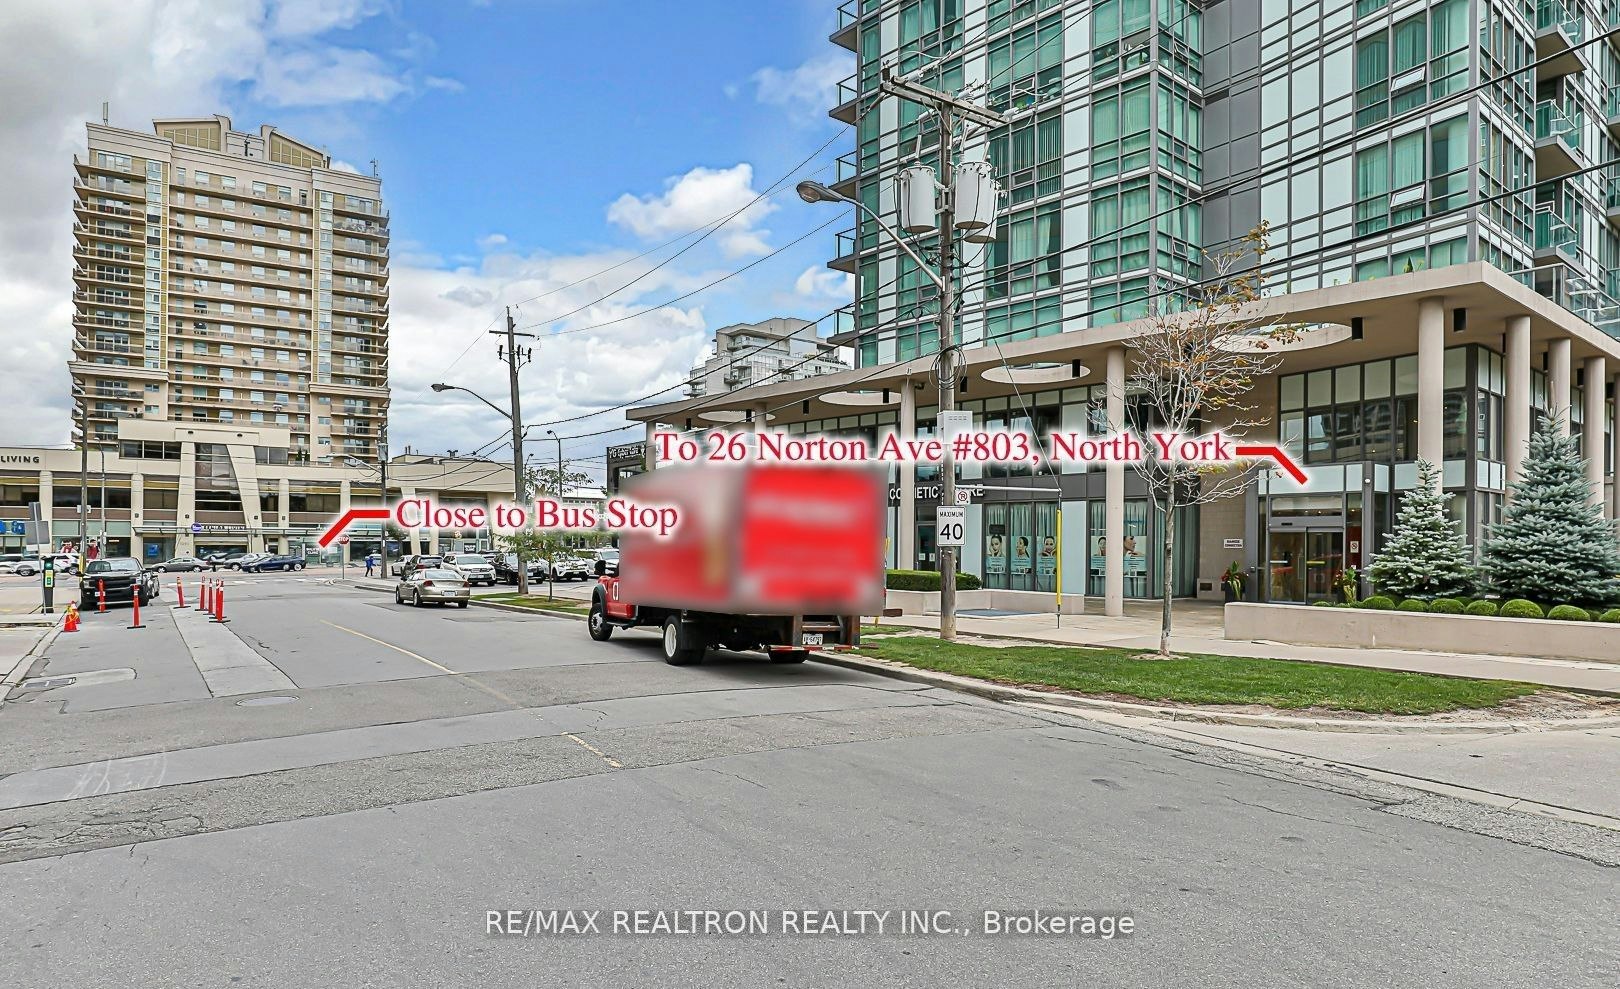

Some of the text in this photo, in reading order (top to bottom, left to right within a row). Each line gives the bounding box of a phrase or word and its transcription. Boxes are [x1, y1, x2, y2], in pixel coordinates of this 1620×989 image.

[0, 455, 40, 464] LIVING
[889, 486, 939, 500] COETIC
[939, 523, 964, 540] 40
